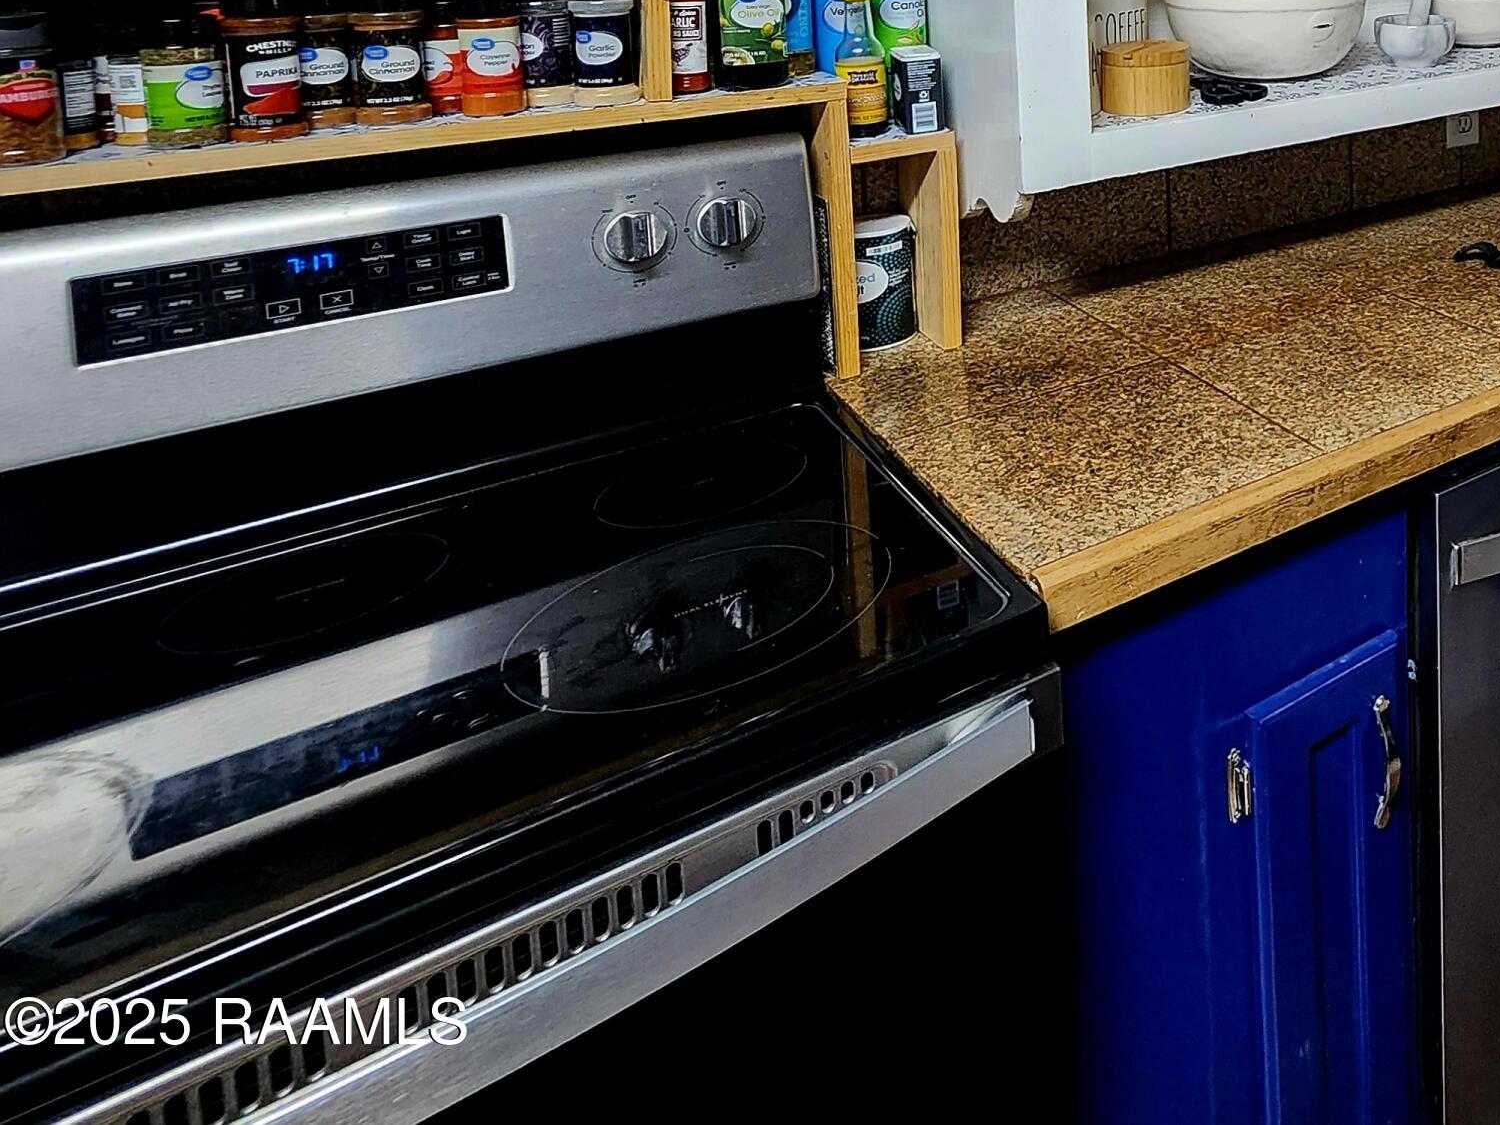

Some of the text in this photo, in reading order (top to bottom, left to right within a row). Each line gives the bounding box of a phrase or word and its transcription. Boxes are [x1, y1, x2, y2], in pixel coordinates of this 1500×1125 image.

[737, 9, 765, 19] Olive
[671, 16, 696, 28] ARLIC
[1094, 8, 1146, 46] OFFEE
[588, 44, 616, 53] Garlic
[309, 61, 345, 71] Ground
[380, 58, 415, 69] Ground
[255, 66, 298, 79] PAPRIKA
[368, 66, 416, 76] Cinnamon
[287, 253, 335, 274] 7:17
